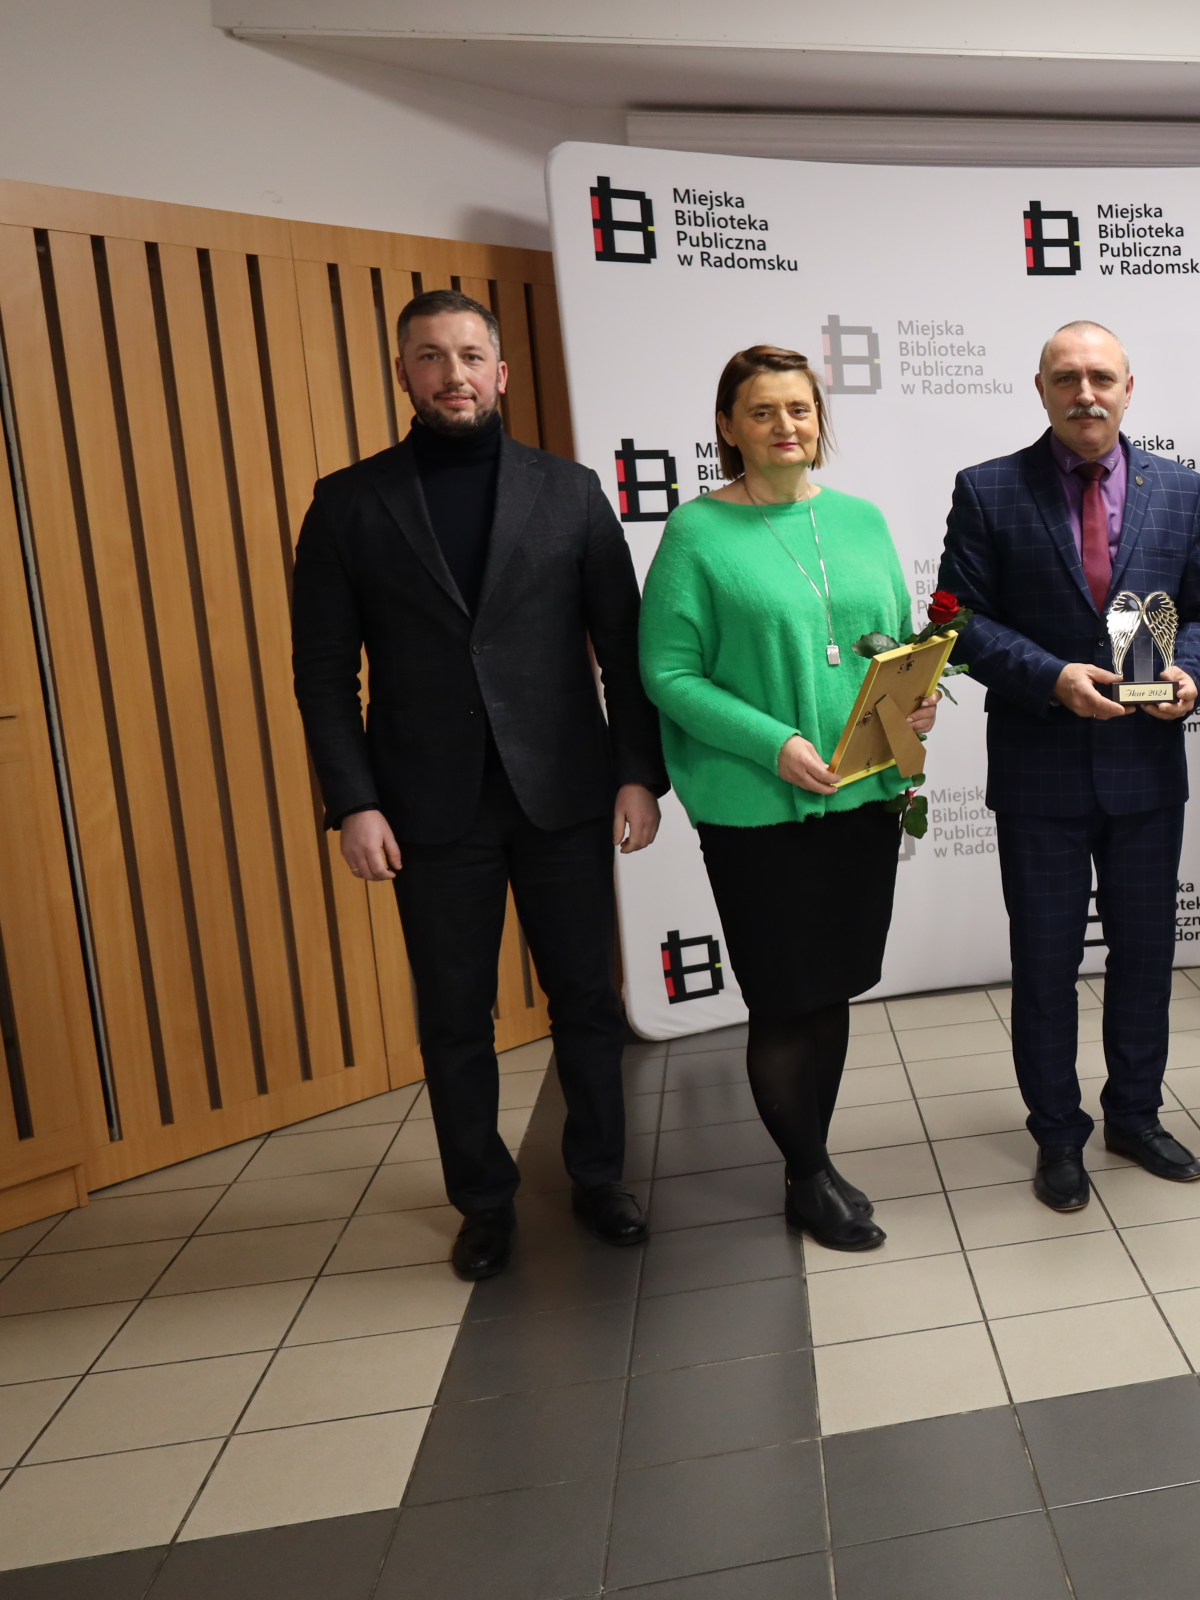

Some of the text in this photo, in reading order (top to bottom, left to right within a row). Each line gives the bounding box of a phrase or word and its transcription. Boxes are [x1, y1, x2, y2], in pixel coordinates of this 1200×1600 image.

[673, 188, 745, 211] Miejska
[675, 210, 769, 231] Biblioteka
[1097, 203, 1163, 222] Miejska
[1098, 223, 1184, 239] Biblioteka
[677, 230, 766, 251] Publiczna
[1100, 242, 1181, 258] Publiczna
[677, 251, 798, 271] w Radomsku
[1100, 264, 1114, 275] w
[898, 320, 964, 340] Miejska
[899, 341, 986, 356] Biblioteka
[900, 361, 984, 376] Publiczna
[901, 379, 1012, 394] w Radomsku
[930, 786, 985, 806] Miejsk
[932, 806, 996, 824] Bibliote
[934, 848, 948, 858] w
